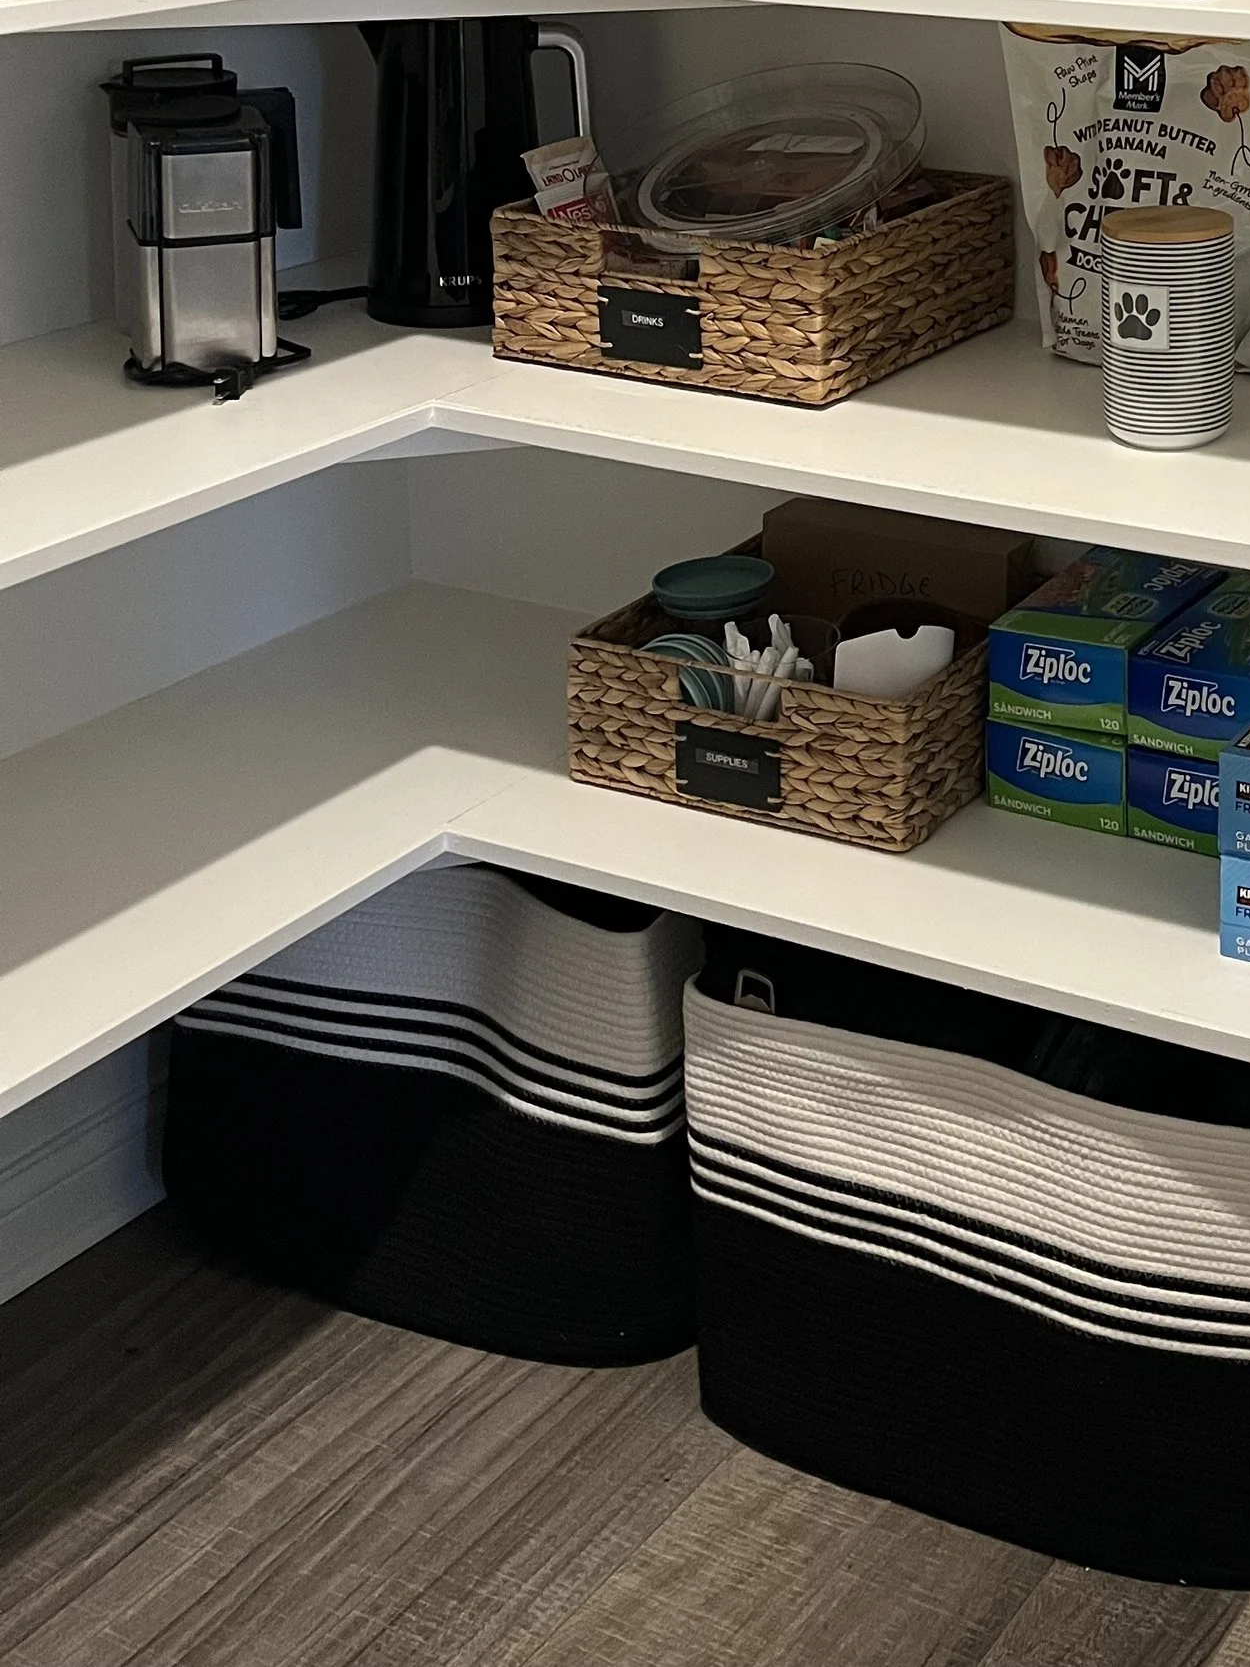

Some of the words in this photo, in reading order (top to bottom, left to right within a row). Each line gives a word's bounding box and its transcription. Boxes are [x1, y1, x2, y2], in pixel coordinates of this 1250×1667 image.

[1053, 62, 1075, 81] Paw
[1076, 54, 1099, 72] Print
[1068, 69, 1098, 88] Shape
[1118, 90, 1161, 103] Member's
[1125, 100, 1149, 110] Mark
[1105, 136, 1168, 160] BANANA
[1157, 122, 1218, 157] BUTTER
[439, 274, 483, 287] KRUPS
[631, 313, 664, 328] DRINKS
[830, 567, 932, 598] FRIDGE
[1159, 620, 1222, 659] Ziploc
[1026, 648, 1092, 684] Ziploc
[1167, 680, 1236, 717] Ziploc
[993, 701, 1052, 721] SANDWICH
[1099, 718, 1120, 731] 120
[1132, 734, 1194, 756] SANDWICH
[705, 752, 749, 769] SUPPLIES
[1023, 742, 1089, 782] Ziploc
[1170, 772, 1220, 810] Ziplo
[993, 794, 1052, 816] SANDWICH
[1099, 817, 1119, 831] 120
[1133, 826, 1196, 850] SANDWICH
